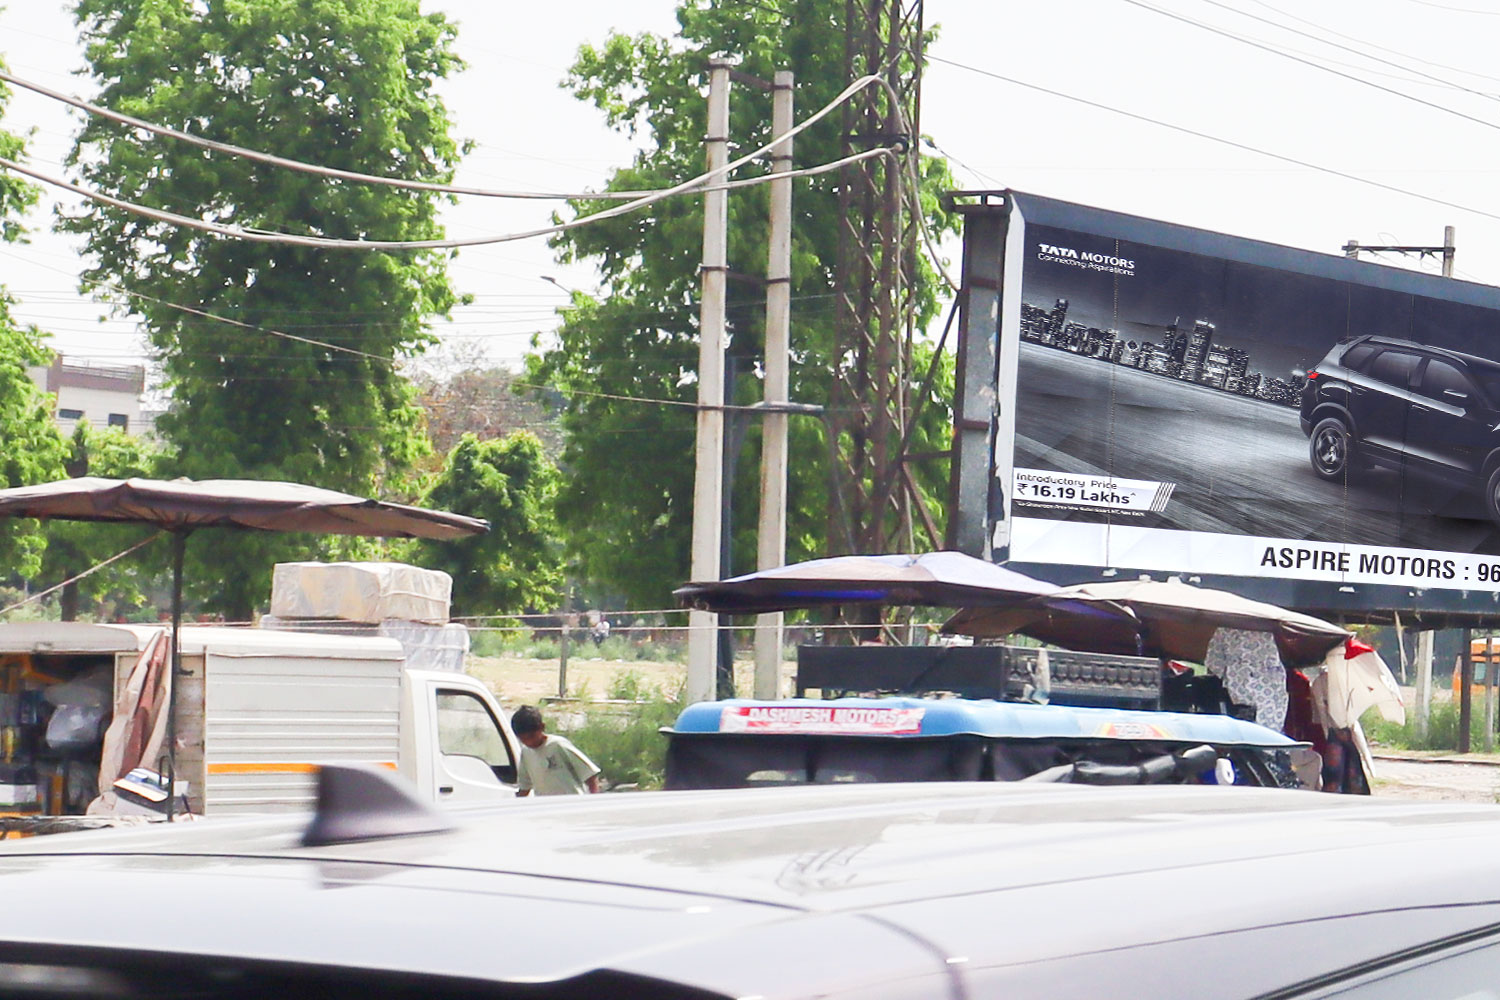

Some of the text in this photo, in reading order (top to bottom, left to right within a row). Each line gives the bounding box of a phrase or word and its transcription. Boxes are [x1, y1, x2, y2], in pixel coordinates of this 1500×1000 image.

[1038, 243, 1135, 269] TATA MOTORS
[1016, 473, 1117, 490] Introductory Price
[1031, 484, 1076, 499] 16.19
[1260, 546, 1350, 573] ASPIRE
[1359, 553, 1456, 580] MOTORS
[750, 708, 899, 723] DASHMESH MOTORS
